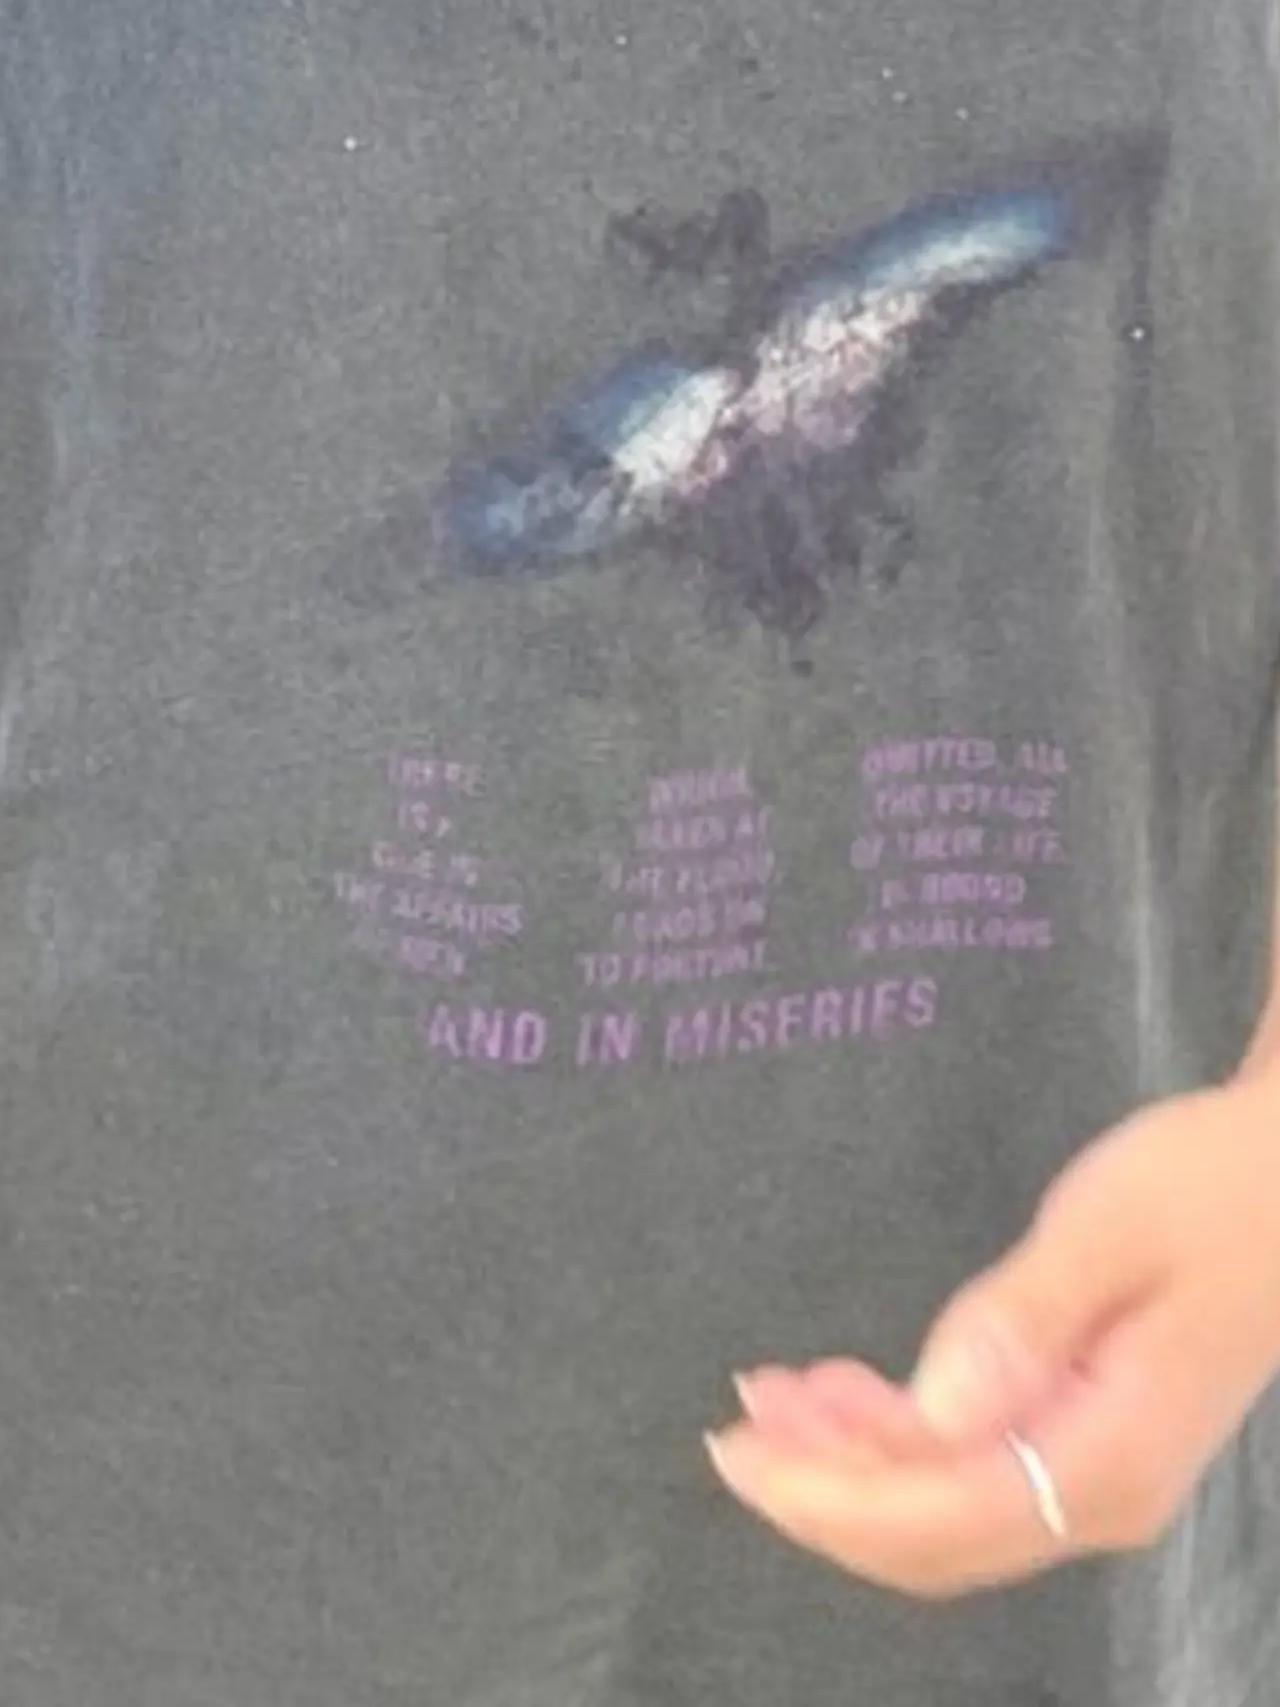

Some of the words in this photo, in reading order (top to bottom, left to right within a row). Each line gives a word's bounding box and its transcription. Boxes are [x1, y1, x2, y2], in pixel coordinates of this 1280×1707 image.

[428, 1003, 547, 1065] AND
[576, 1011, 637, 1066] IN
[664, 978, 939, 1062] MISERIES
